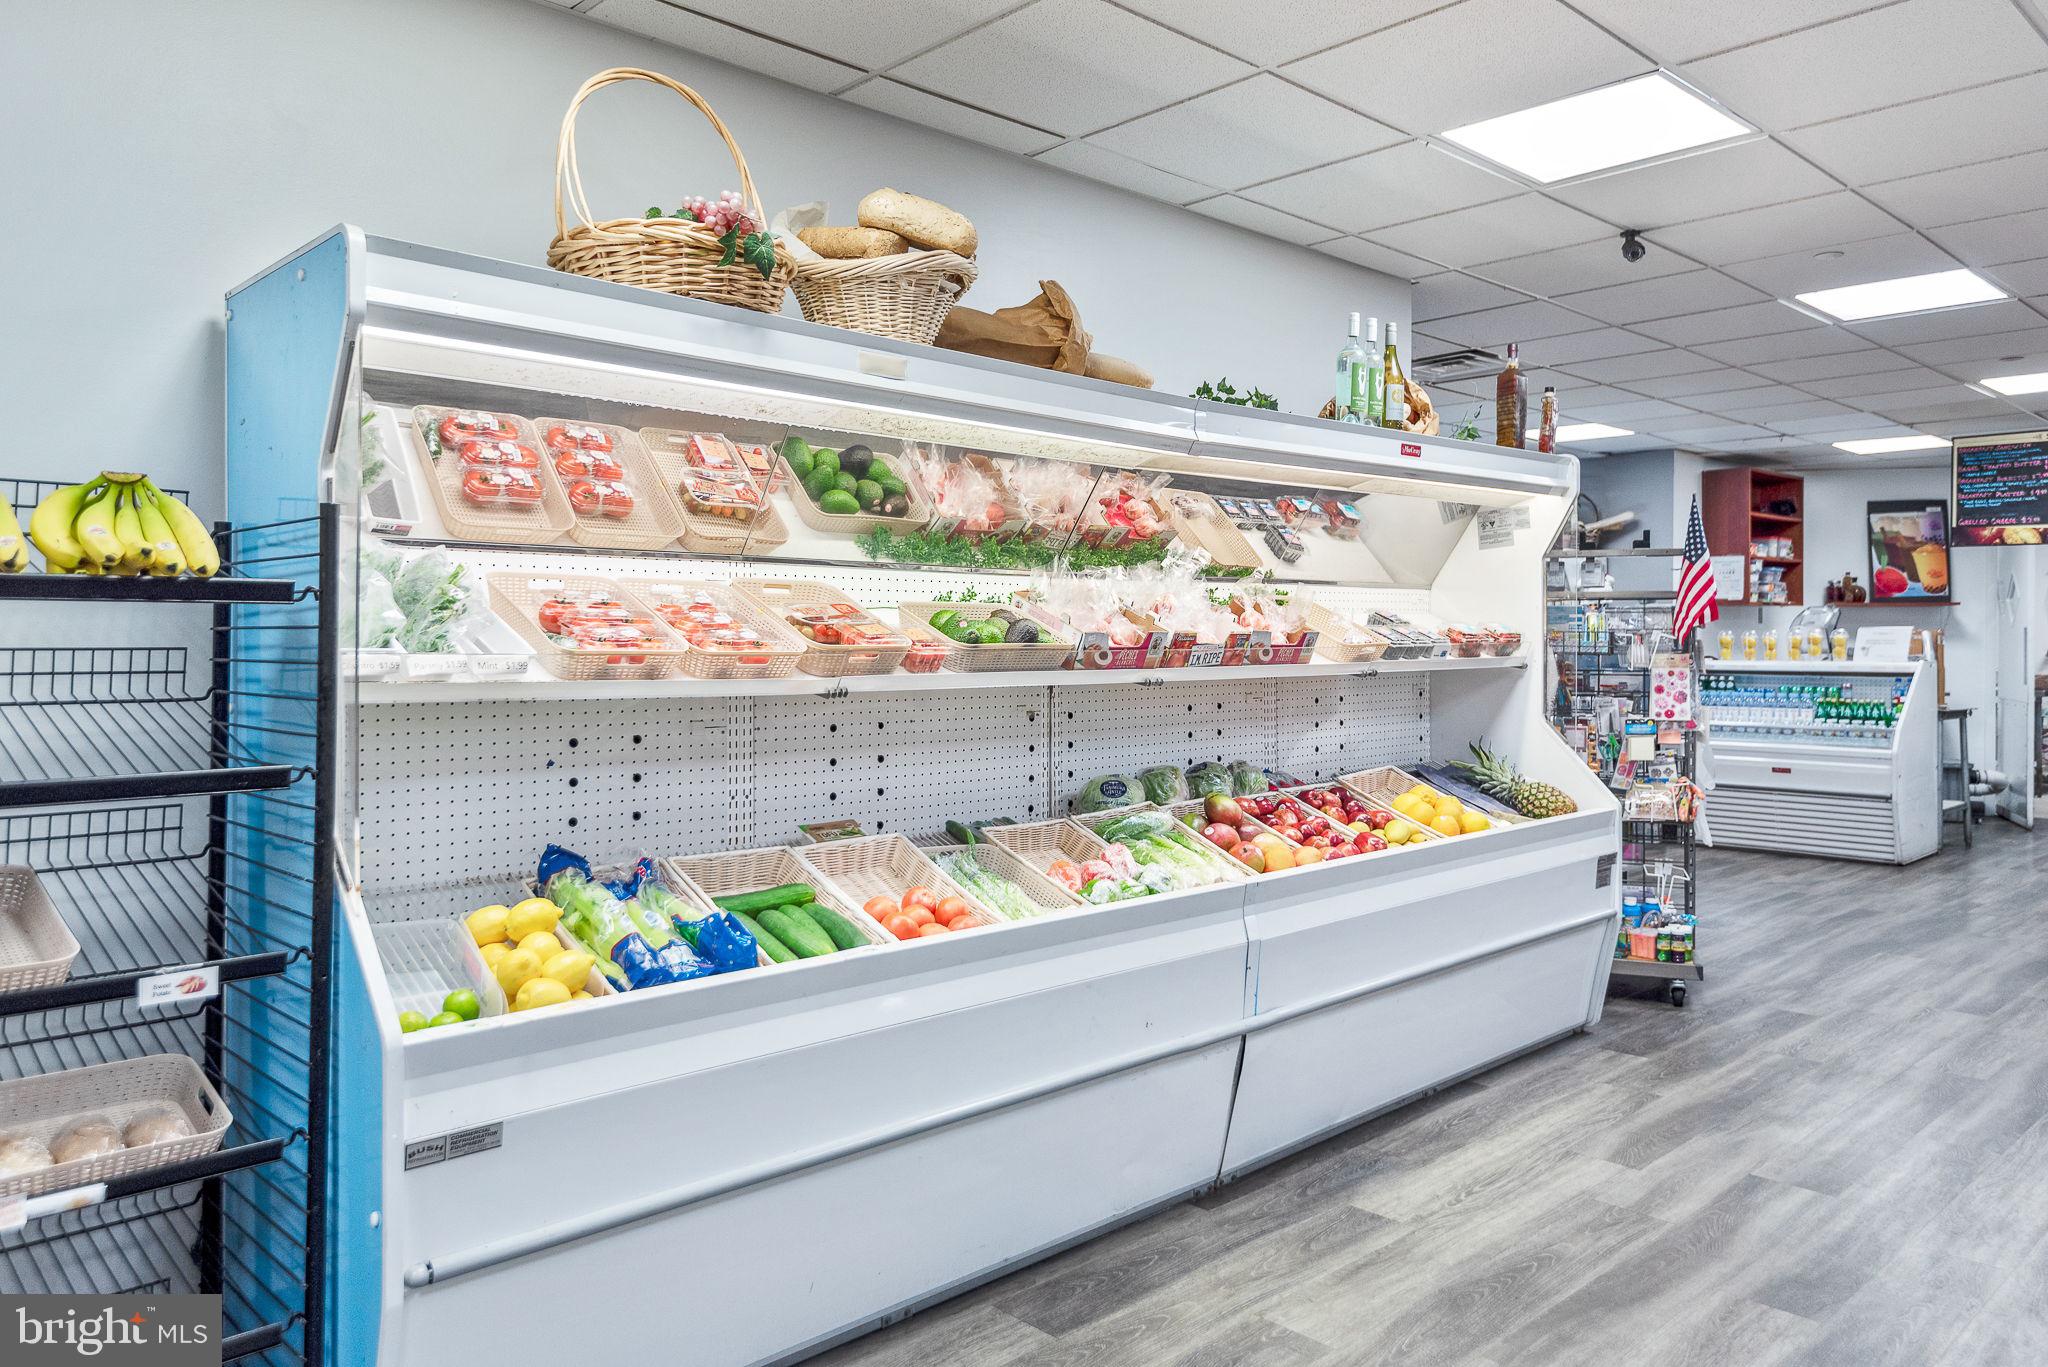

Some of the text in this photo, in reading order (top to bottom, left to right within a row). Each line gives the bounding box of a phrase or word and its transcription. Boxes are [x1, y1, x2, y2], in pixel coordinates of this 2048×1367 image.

[1202, 651, 1223, 665] RIPE
[477, 661, 498, 671] Mint
[450, 1126, 492, 1141] COMMERCIAL
[450, 1129, 499, 1146] REFRIGERATION
[449, 1137, 487, 1151] EQUIPMENT
[408, 1144, 445, 1159] BUSH
